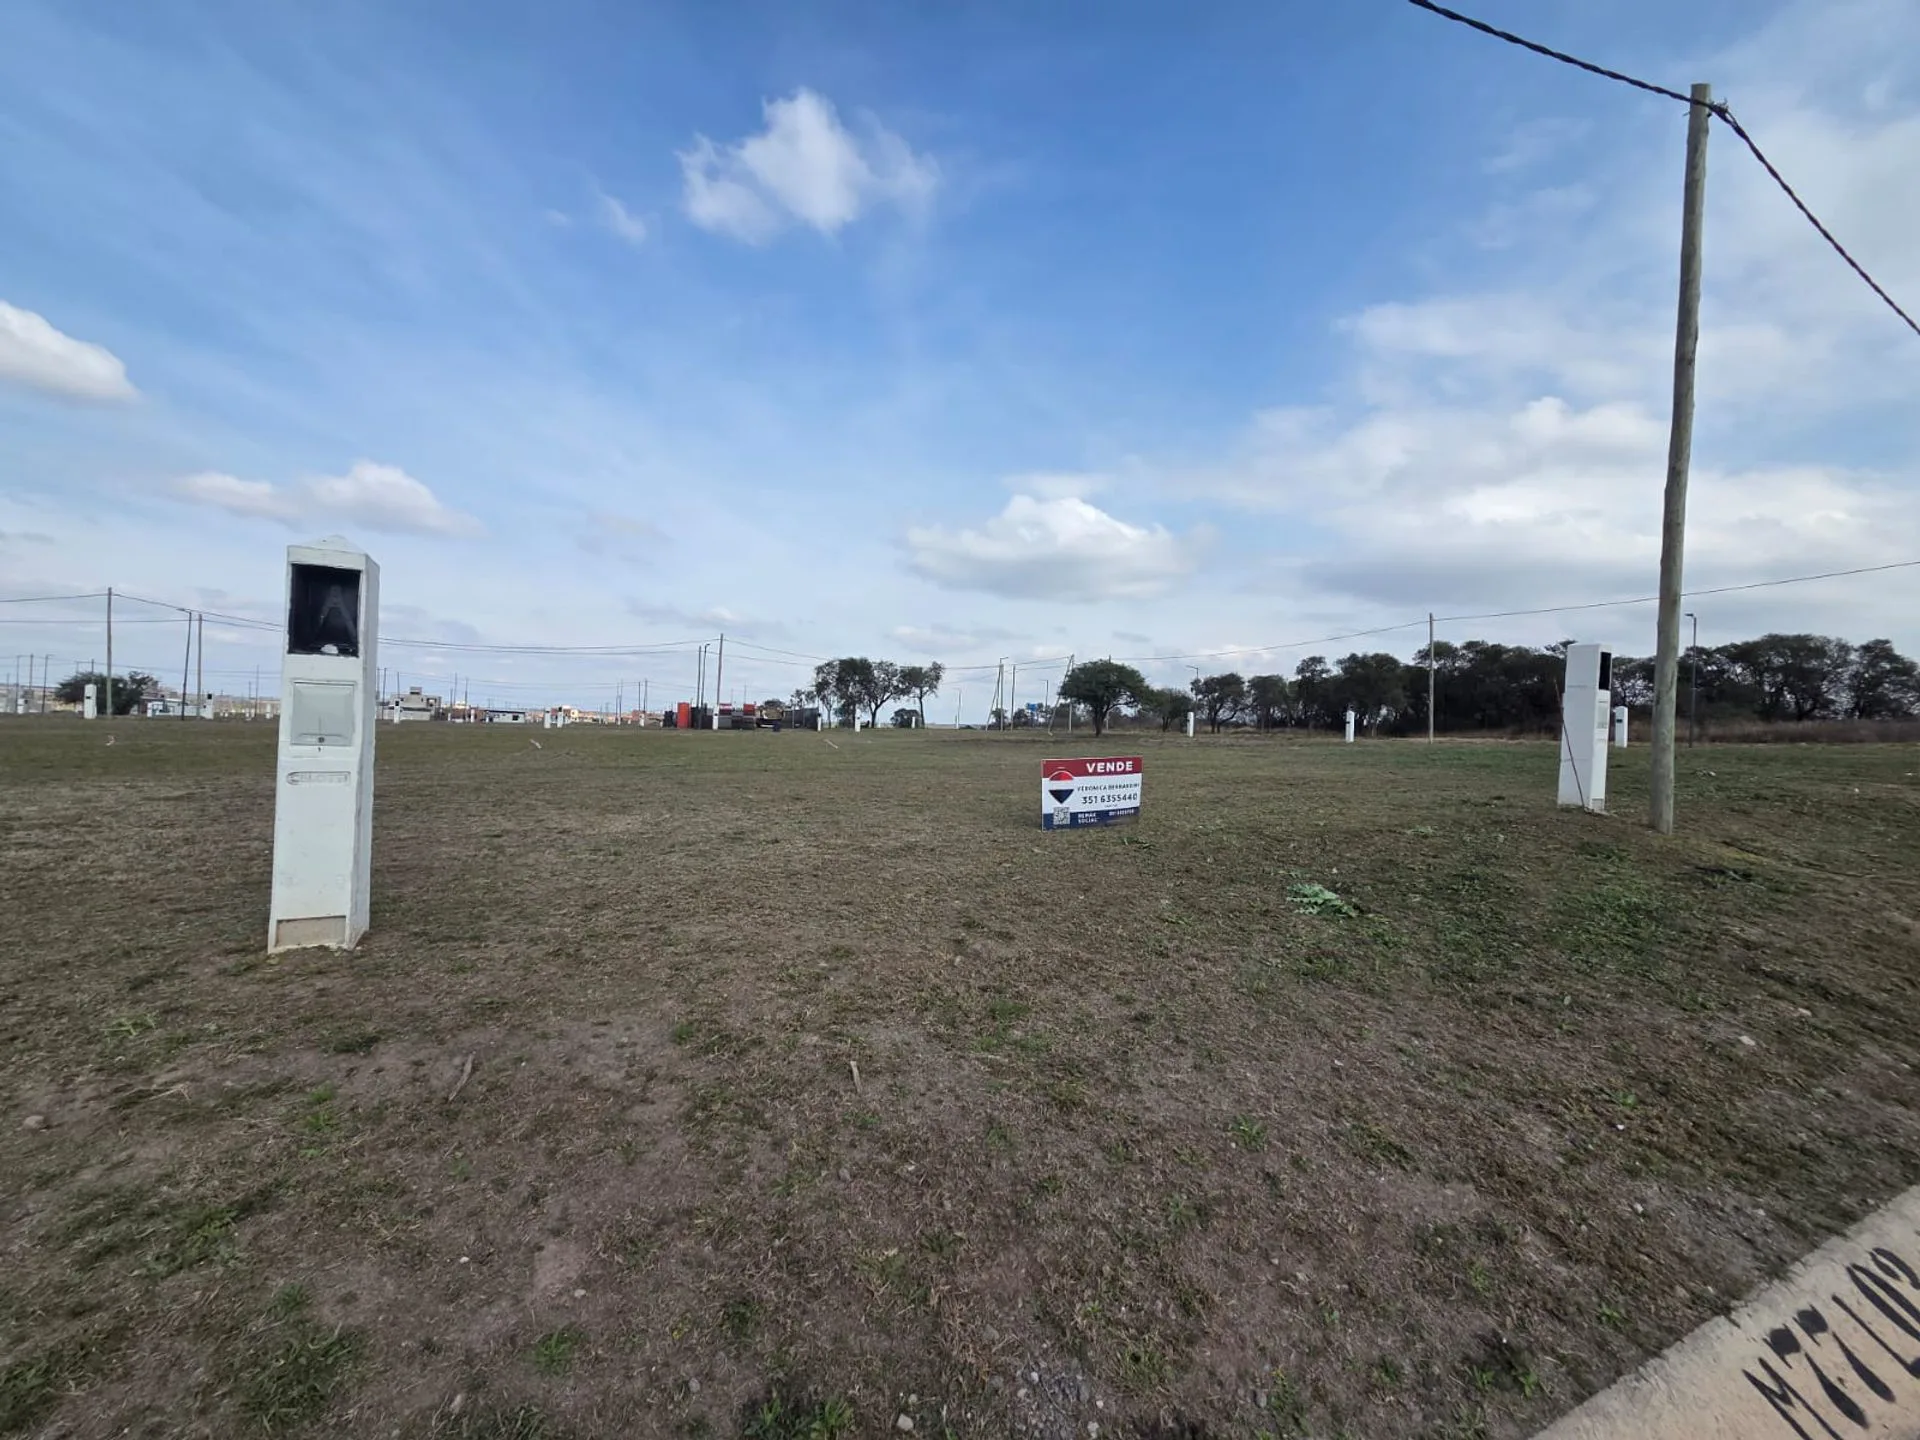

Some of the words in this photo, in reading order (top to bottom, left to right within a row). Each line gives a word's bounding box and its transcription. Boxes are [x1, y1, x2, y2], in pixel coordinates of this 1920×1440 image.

[1086, 761, 1133, 773] VENDE
[1082, 796, 1098, 805] 351
[1100, 793, 1138, 803] 6355440
